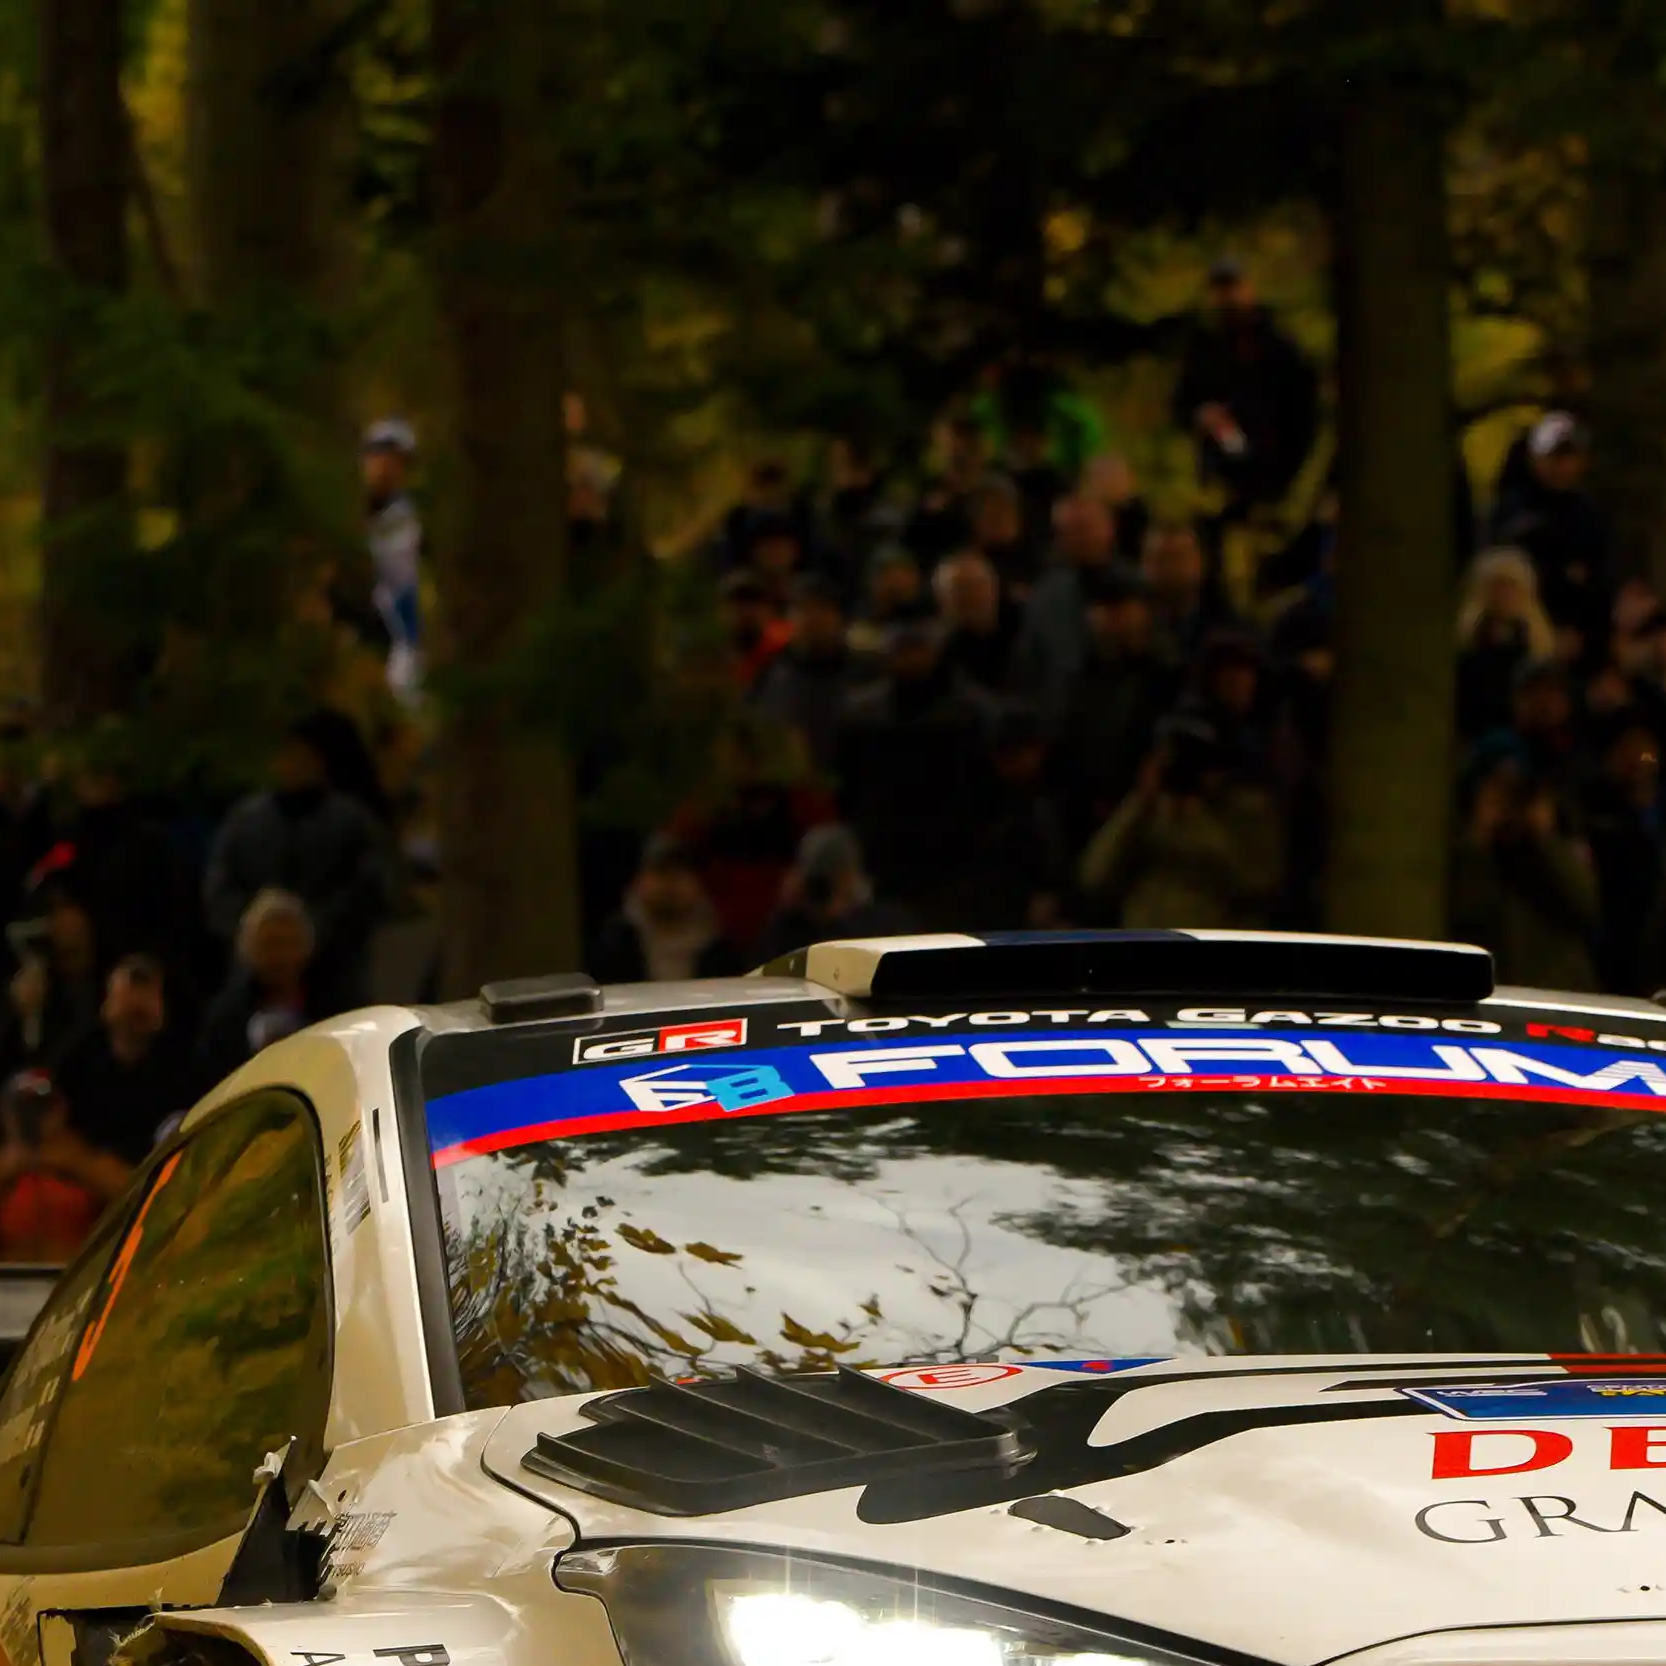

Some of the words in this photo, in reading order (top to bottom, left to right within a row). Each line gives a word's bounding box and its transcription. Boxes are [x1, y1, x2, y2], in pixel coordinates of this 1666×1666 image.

[777, 1009, 1150, 1037] TOYOTA
[1176, 1007, 1502, 1034] GAZOO
[583, 1030, 737, 1060] GR
[1138, 1075, 1387, 1090] フォーラムエイト
